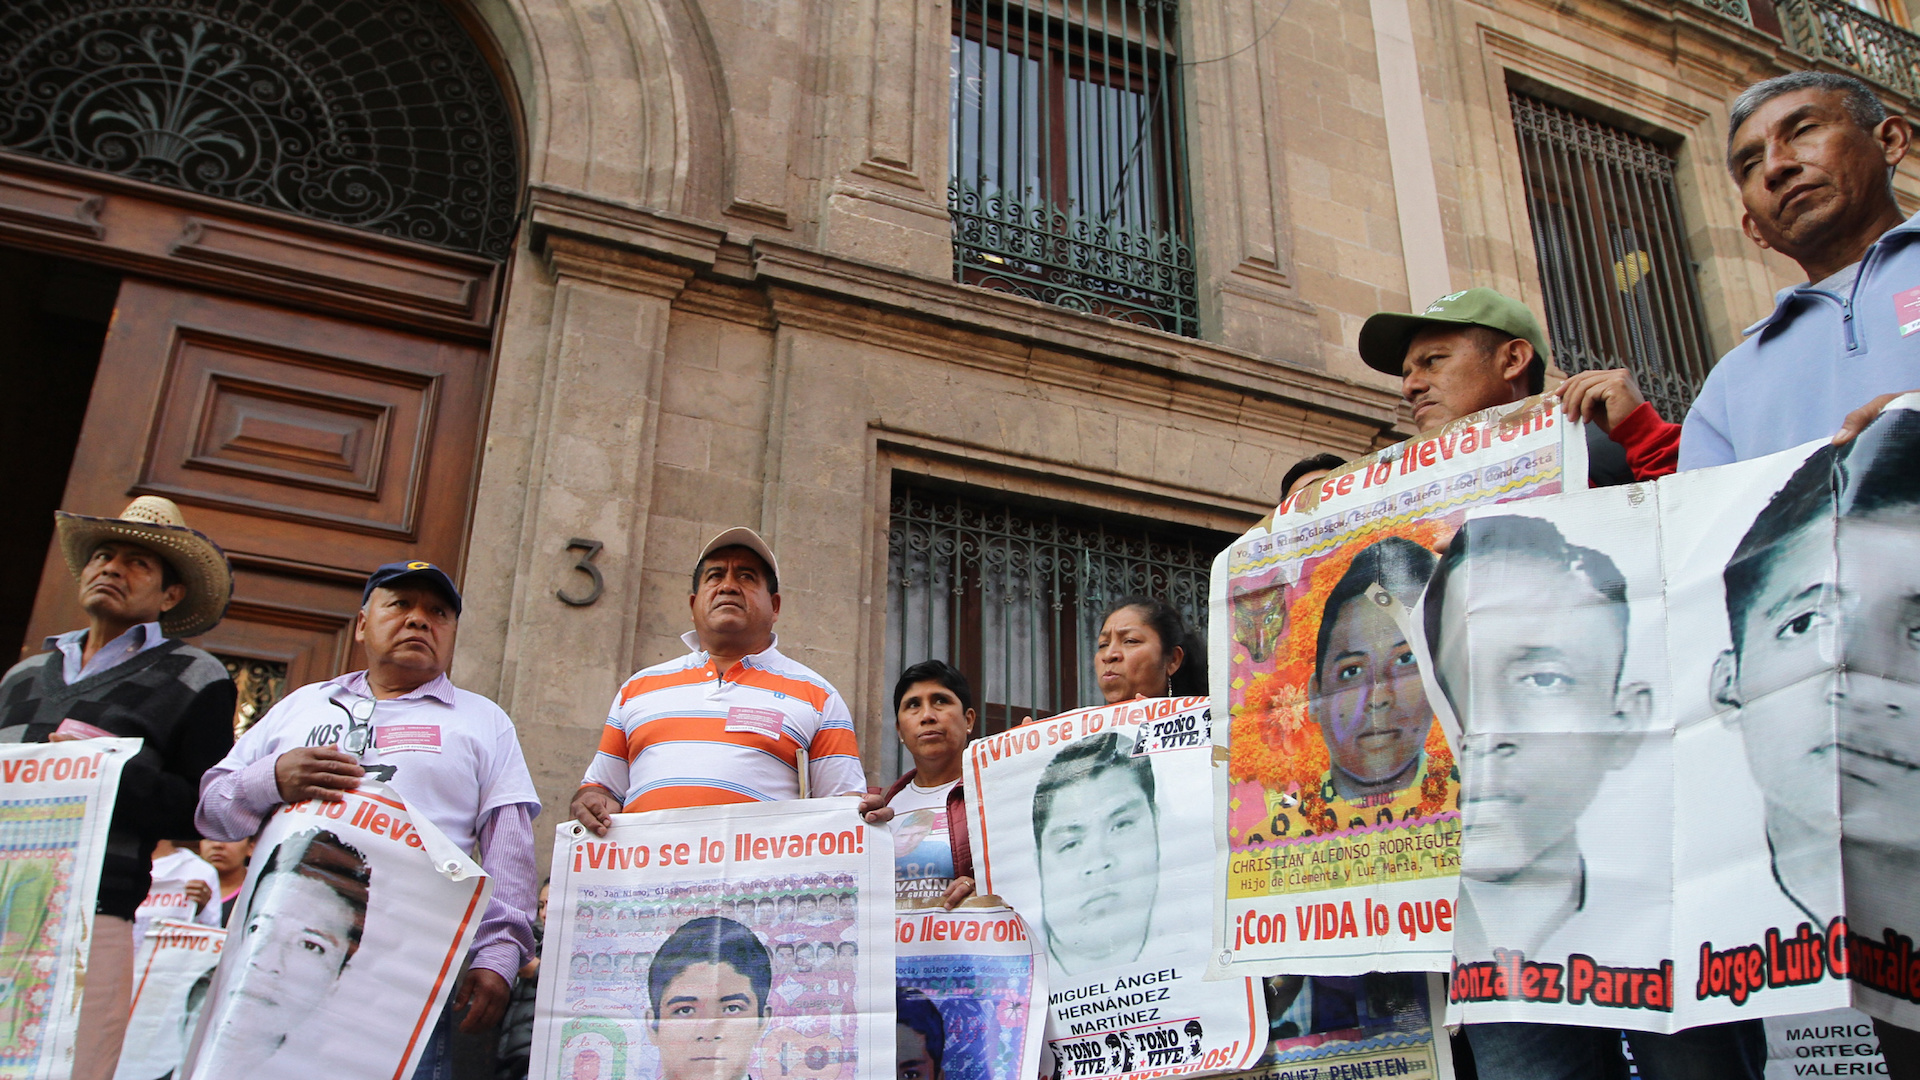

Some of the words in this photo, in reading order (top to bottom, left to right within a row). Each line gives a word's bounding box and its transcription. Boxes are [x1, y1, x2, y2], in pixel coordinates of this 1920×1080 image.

[1272, 488, 1314, 519] vo
[1321, 474, 1355, 502] se
[1363, 457, 1392, 489] lo
[1400, 408, 1554, 476] llevaron!
[1257, 542, 1273, 553] Jan
[1404, 488, 1441, 506] quiero
[1446, 477, 1479, 493] saber
[1525, 453, 1553, 470] está
[557, 538, 604, 607] 3
[305, 724, 343, 747] NOS
[979, 729, 1041, 769] ¡Vivo
[1048, 721, 1073, 746] se
[1082, 713, 1104, 736] lo
[1160, 730, 1200, 749] VIVE
[0, 752, 104, 784] varon!
[350, 800, 427, 852] lleva
[573, 841, 650, 873] ¡Vivo
[659, 842, 690, 867] se
[699, 836, 725, 863] lo
[734, 825, 864, 862] llevaron!
[1233, 852, 1304, 874] CHRISTIAN
[1312, 843, 1370, 865] ALFONSO
[604, 889, 619, 898] Jan
[740, 880, 770, 891] quiero
[774, 878, 798, 887] saber
[895, 879, 953, 893] VANN
[1241, 878, 1266, 892] Hijo
[1271, 876, 1284, 888] de
[1289, 871, 1339, 885] Clemente
[1344, 870, 1350, 882] y
[1358, 865, 1376, 877] Luz
[895, 917, 915, 943] lo
[920, 915, 1026, 942] llevaron!
[1234, 909, 1287, 951] ¡Con
[1295, 900, 1359, 942] VIDA
[1365, 898, 1390, 936] lo
[1398, 897, 1459, 942] que
[212, 939, 224, 953] s
[923, 966, 949, 974] quiero
[953, 965, 976, 973] saber
[1698, 943, 1765, 1005] Jorge
[1766, 924, 1823, 987] Luis
[1048, 983, 1110, 1006] MIGUEL
[1114, 968, 1183, 991] ÁNGEL
[1569, 955, 1673, 1011] Parral
[1058, 987, 1171, 1020] HERNÁNDEZ
[1070, 1008, 1161, 1035] MARTÍNEZ
[1073, 1057, 1106, 1076] VIVE
[1147, 1046, 1184, 1067] VIVE
[1330, 1057, 1409, 1080] PENITEN
